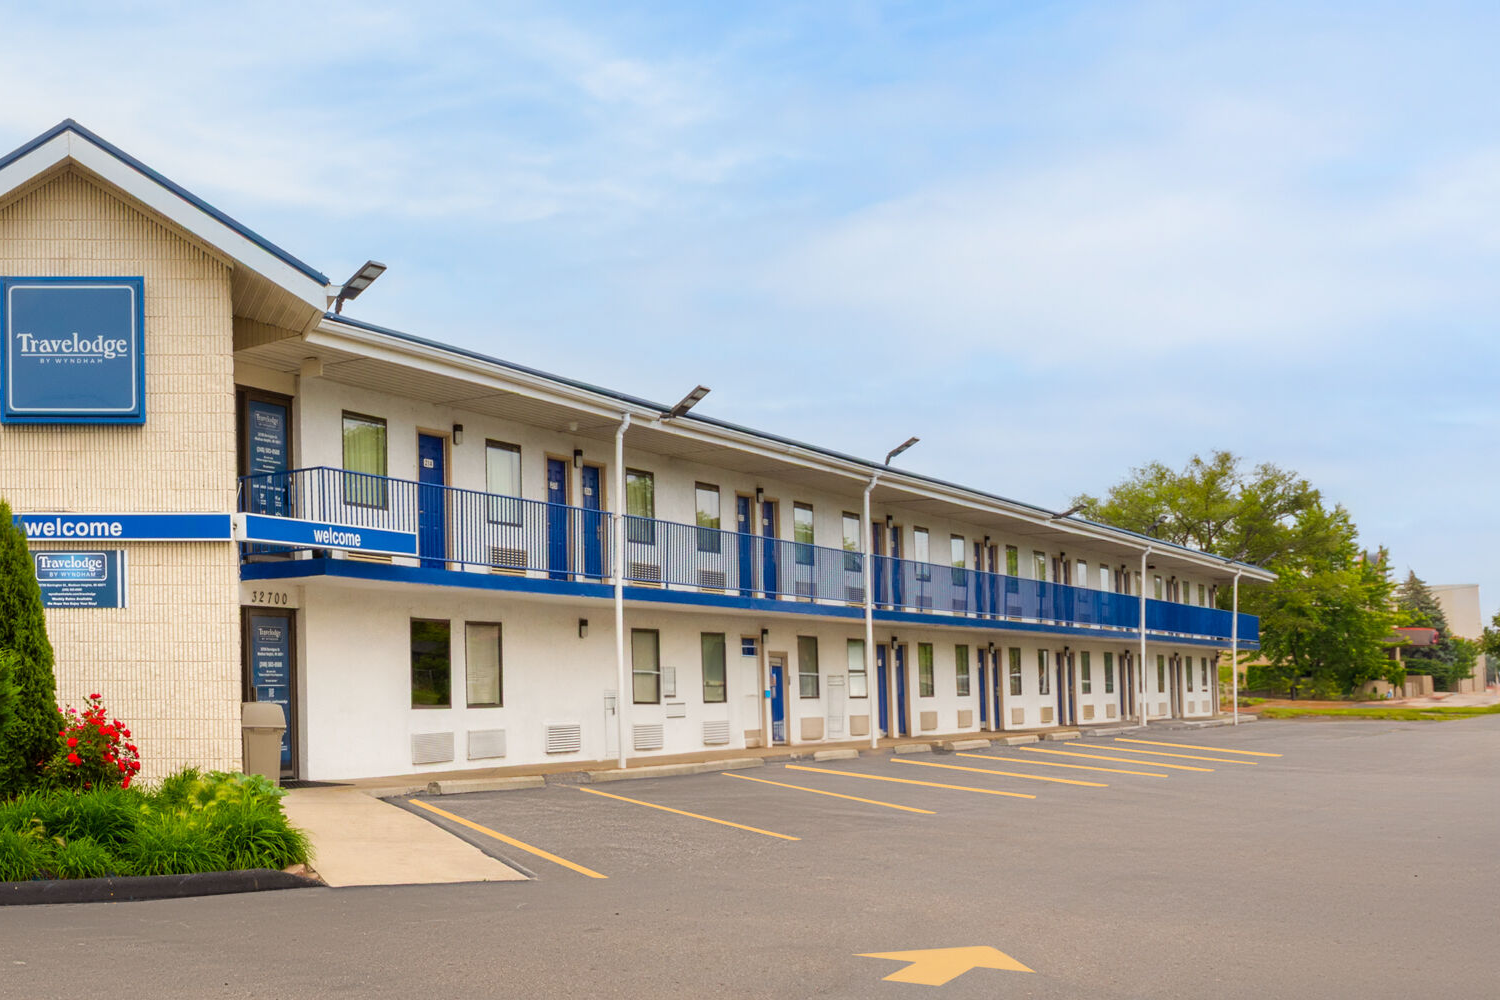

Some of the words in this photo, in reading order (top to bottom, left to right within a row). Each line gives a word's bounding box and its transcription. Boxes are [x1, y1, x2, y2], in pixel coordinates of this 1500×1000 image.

[16, 332, 128, 359] Travelodge
[23, 517, 123, 537] welcome
[313, 526, 361, 547] welcome
[38, 555, 103, 572] Travelodge
[252, 591, 288, 605] 32700
